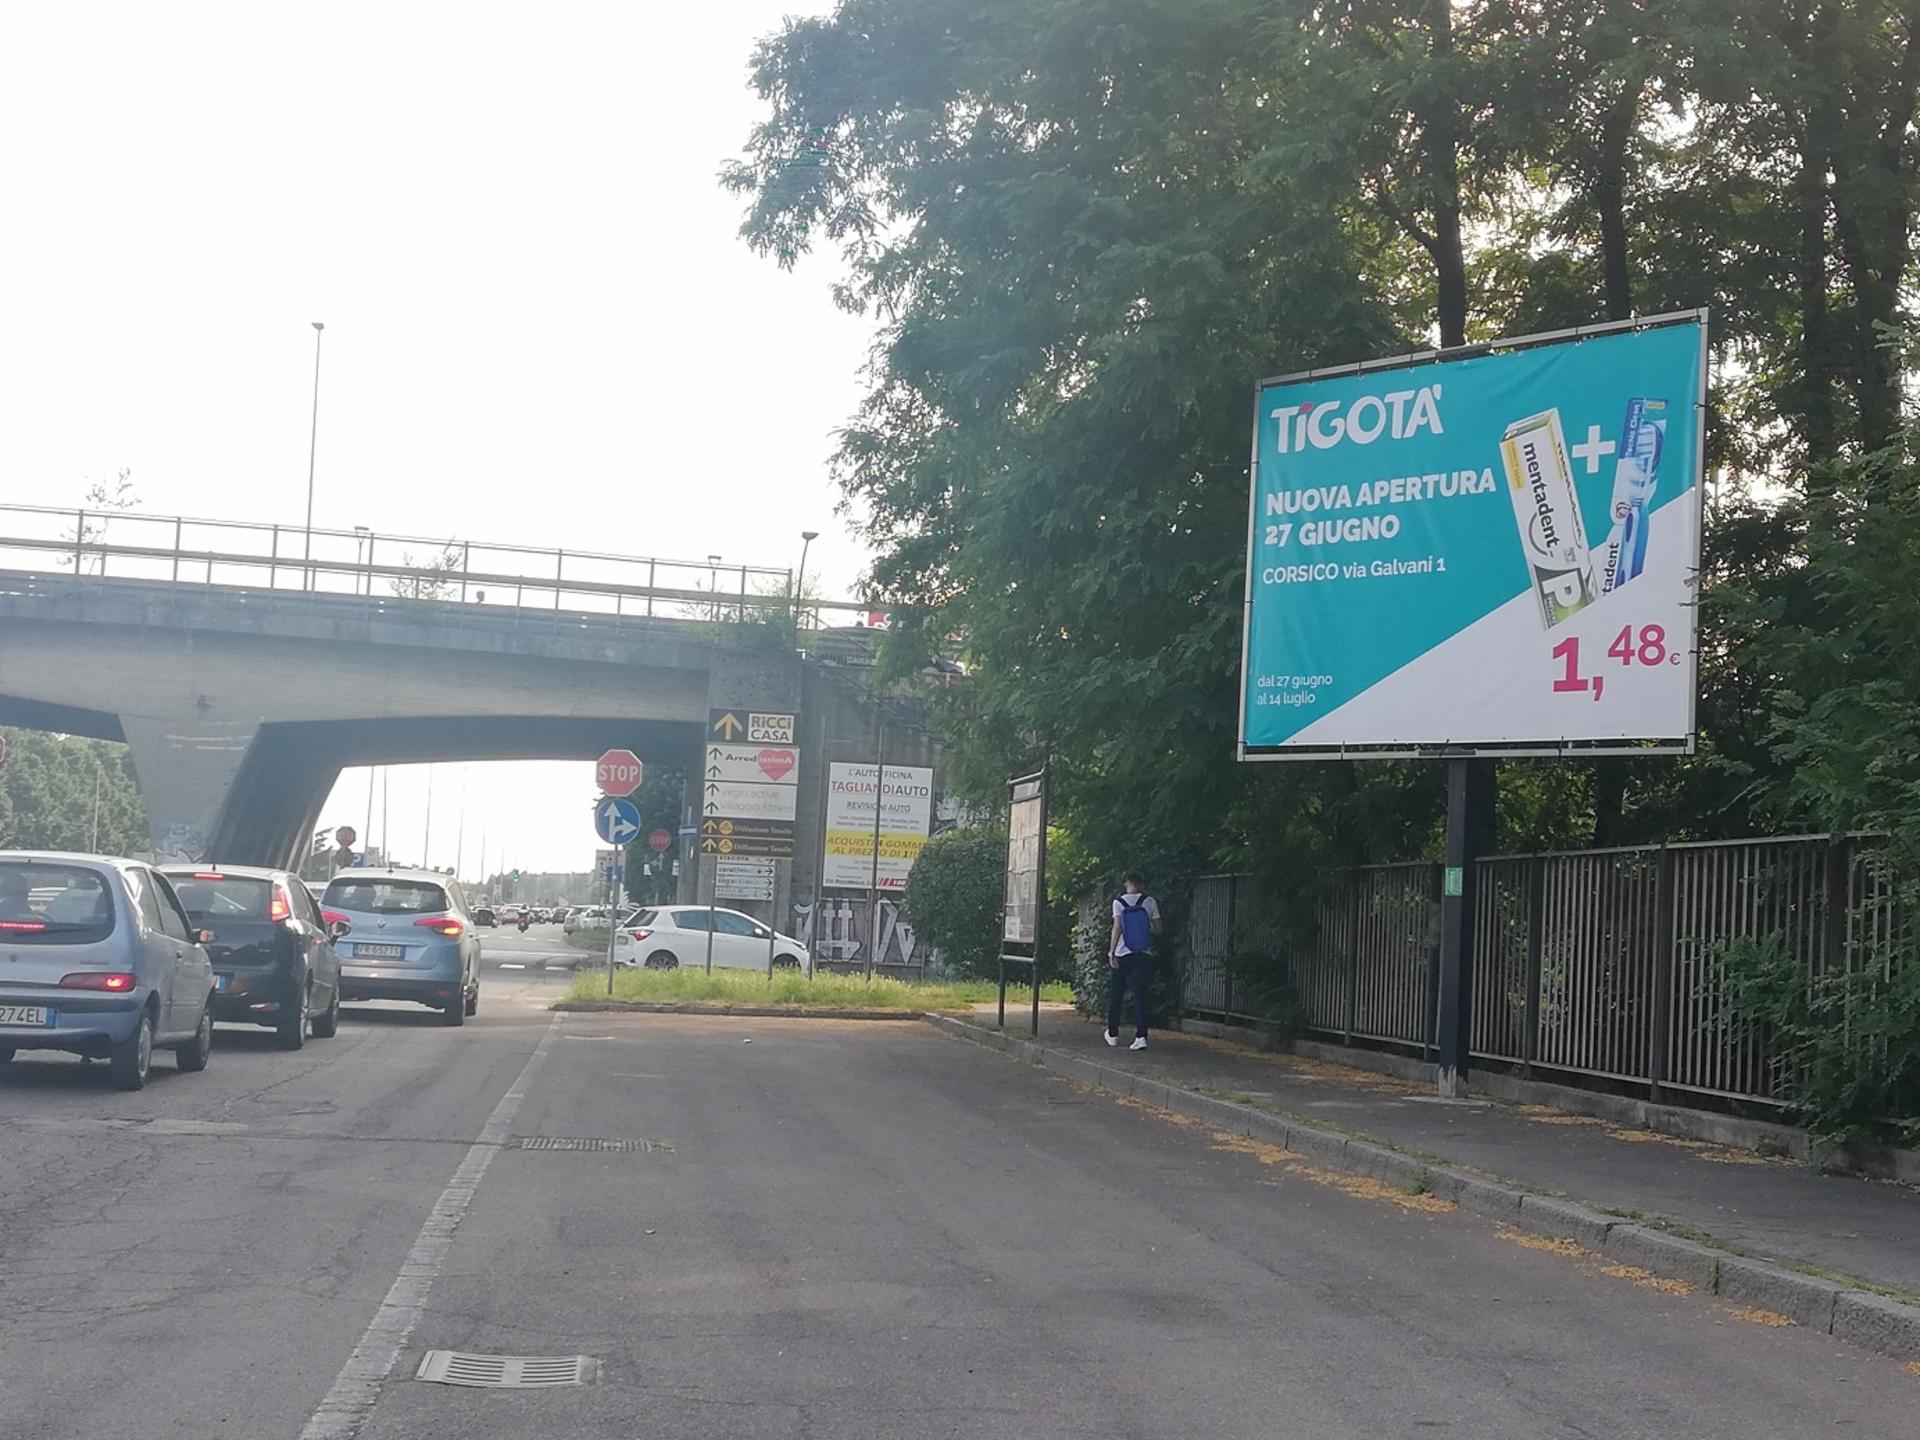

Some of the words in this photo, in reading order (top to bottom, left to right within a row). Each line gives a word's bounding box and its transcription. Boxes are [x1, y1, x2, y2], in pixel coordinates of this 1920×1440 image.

[1265, 485, 1352, 516] NUOVA
[1355, 468, 1497, 506] APERTURA
[1522, 442, 1560, 549] mentadent
[1264, 523, 1293, 547] 27
[1298, 514, 1401, 546] GIUGNO
[1262, 562, 1339, 584] CORSICO
[1343, 563, 1367, 580] via
[1370, 555, 1433, 578] Galvani
[1435, 557, 1446, 573] 1
[1257, 674, 1275, 688] dal
[1276, 675, 1291, 688] 27
[1292, 674, 1333, 689] giugno
[1257, 691, 1267, 705] al
[1269, 693, 1281, 707] 14
[1283, 690, 1316, 707] luglio
[751, 716, 792, 729] RICCI
[750, 729, 790, 741] CASA
[598, 764, 639, 782] STOP
[888, 803, 911, 813] AUTO
[848, 847, 887, 857] PREZO
[885, 839, 924, 850] GOMM
